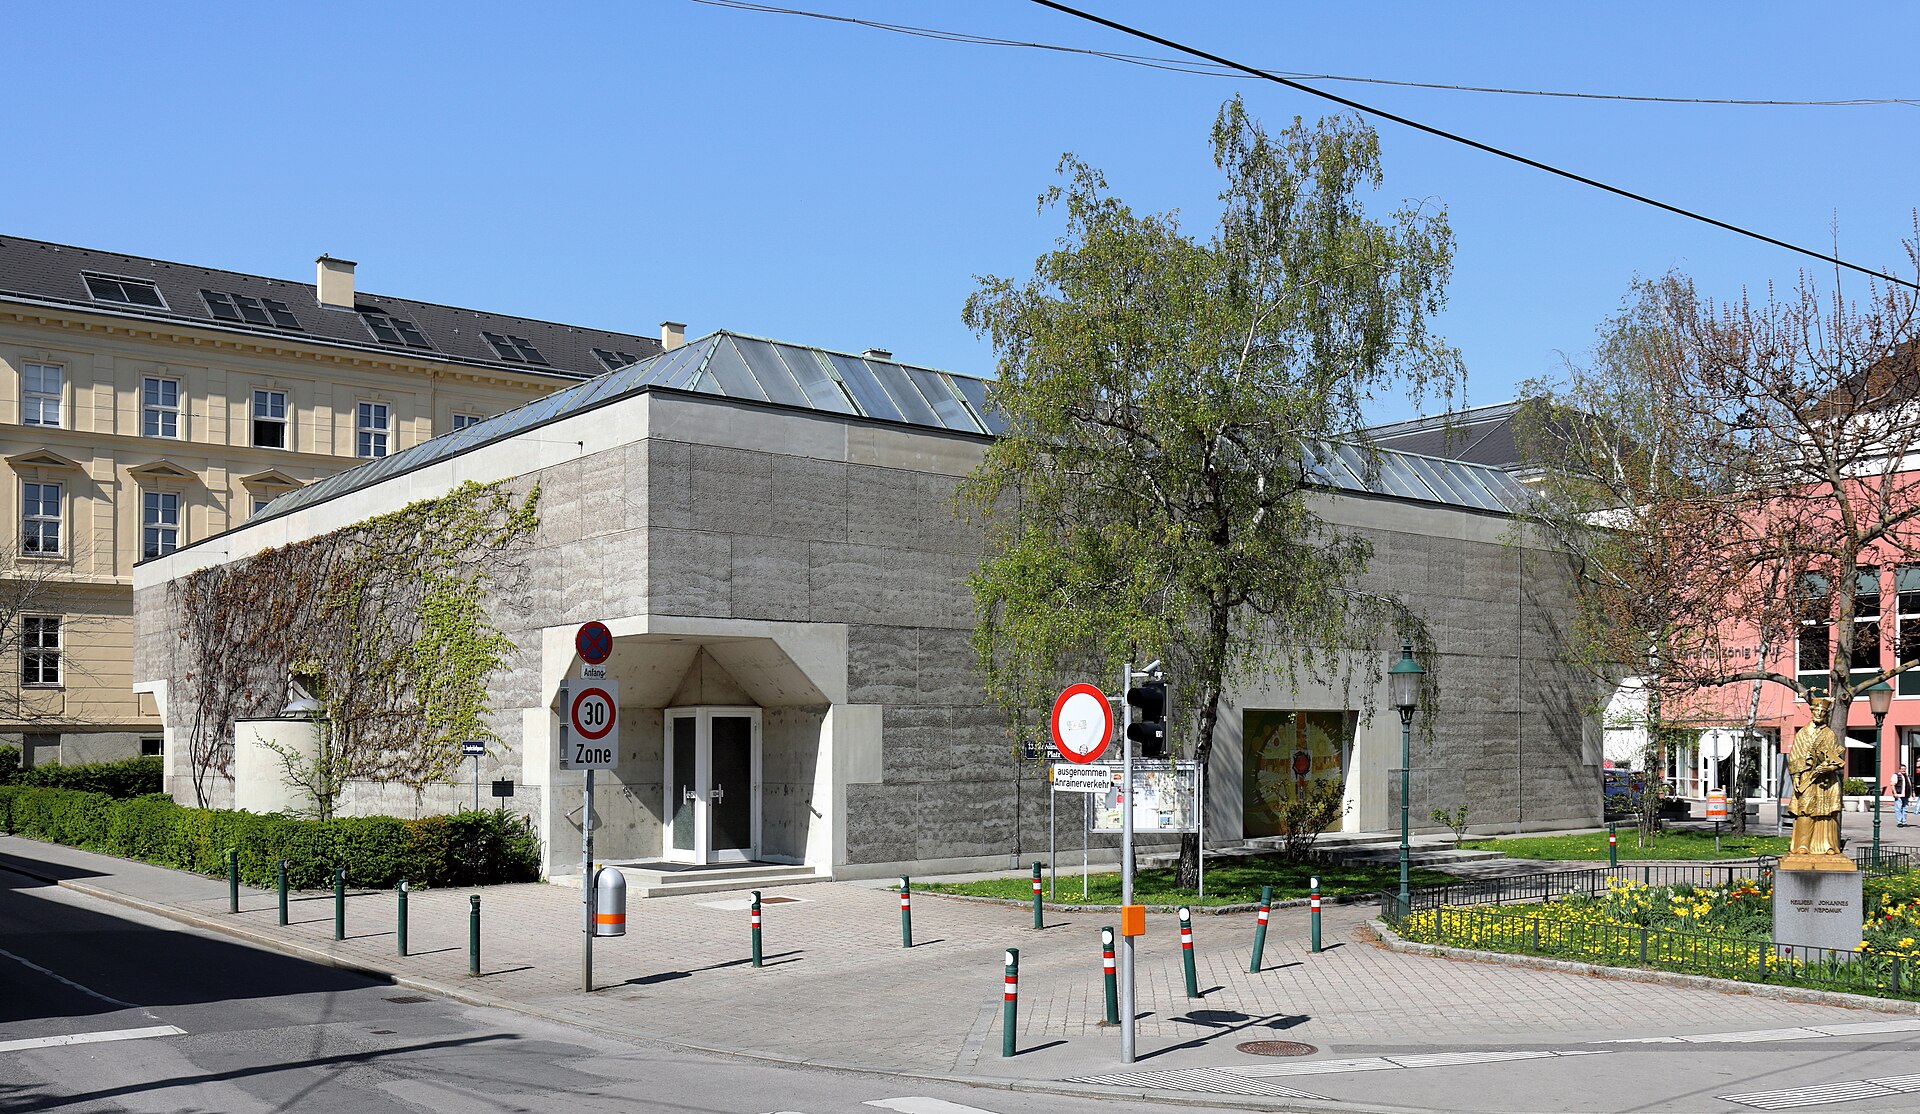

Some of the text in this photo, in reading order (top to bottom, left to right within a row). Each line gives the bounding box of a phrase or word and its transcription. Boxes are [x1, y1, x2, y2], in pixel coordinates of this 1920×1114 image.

[584, 668, 604, 678] Anfang
[584, 702, 604, 726] 30
[575, 743, 612, 764] Zone
[1057, 767, 1107, 780] ausgenommen
[1054, 778, 1110, 790] Anrainerverkehr
